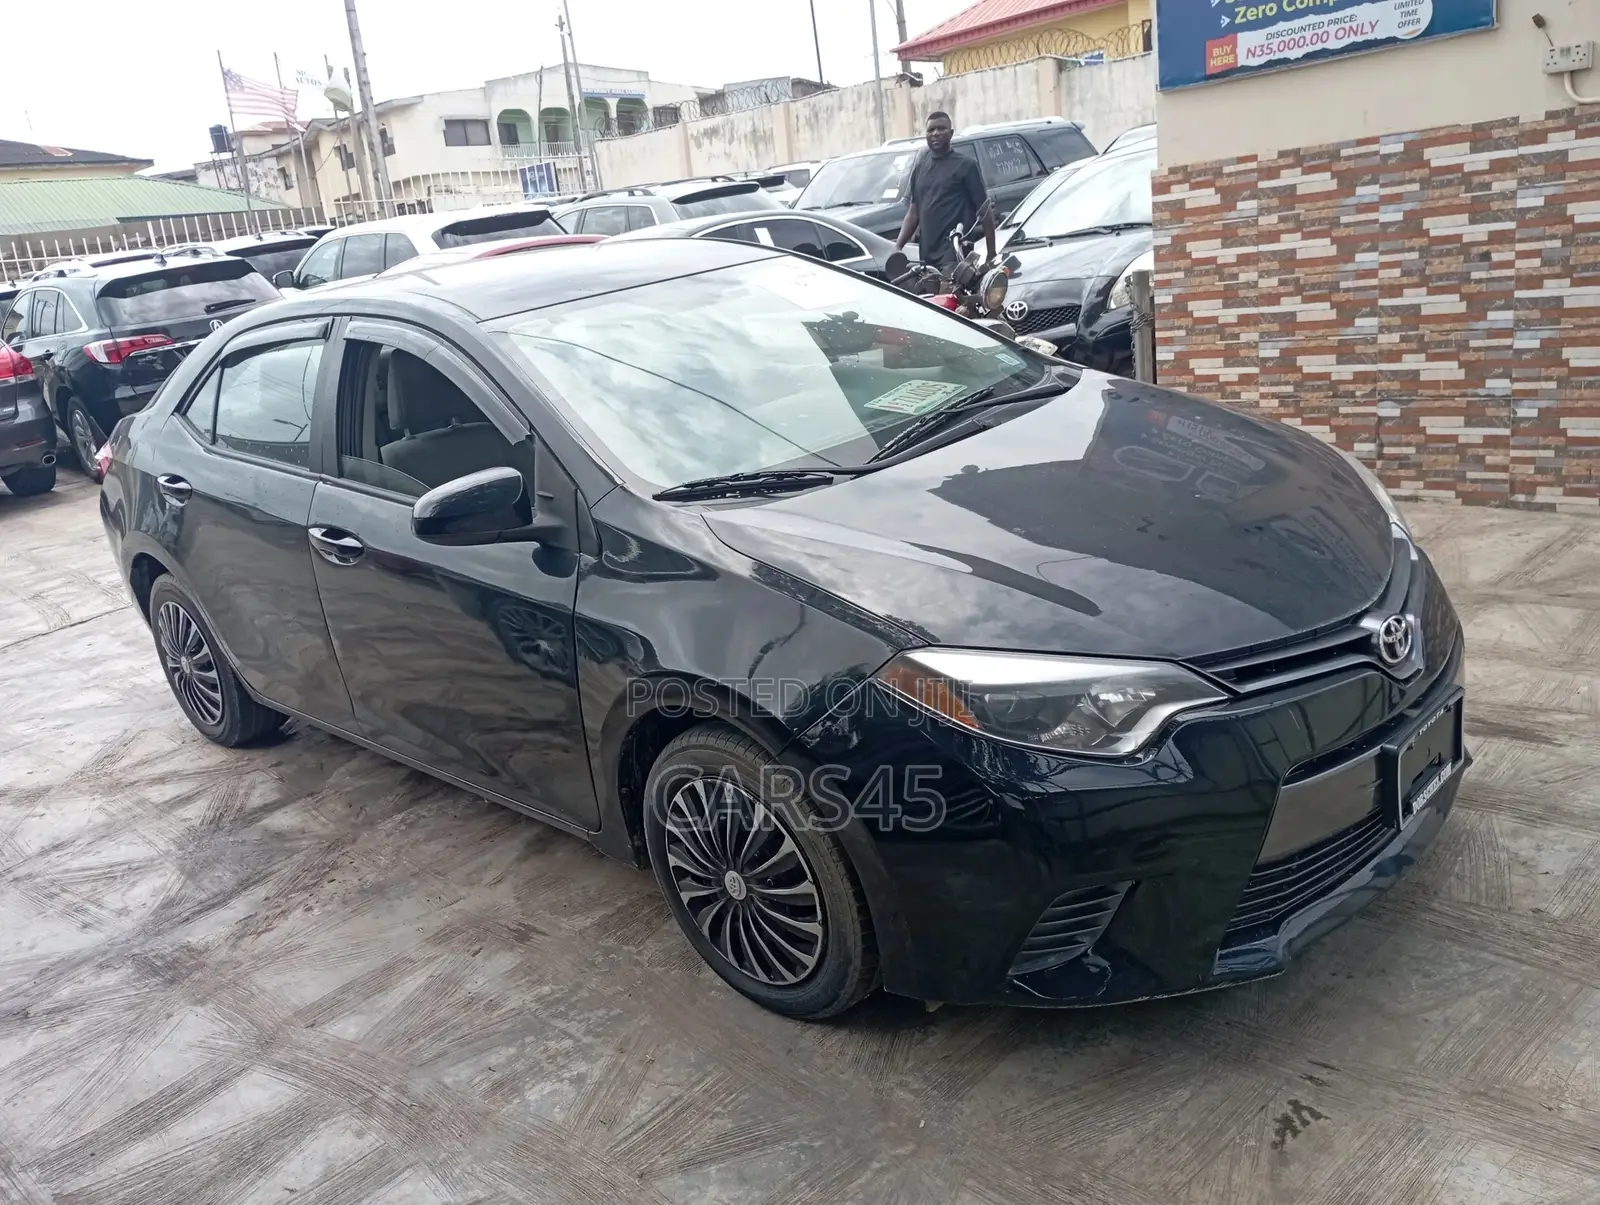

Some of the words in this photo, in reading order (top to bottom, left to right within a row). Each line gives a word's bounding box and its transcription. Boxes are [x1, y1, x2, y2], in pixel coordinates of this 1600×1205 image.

[1394, 0, 1424, 10] LIMITED
[1234, 3, 1277, 24] Zero
[1400, 8, 1418, 18] TIME
[1265, 21, 1325, 41] DISCOUNTED
[1327, 14, 1358, 29] PRICE:
[1397, 18, 1421, 28] OFFER
[1246, 31, 1330, 60] N35,000.00
[1334, 19, 1379, 40] ONLY
[1213, 44, 1232, 57] BUY
[1210, 54, 1235, 67] HERE
